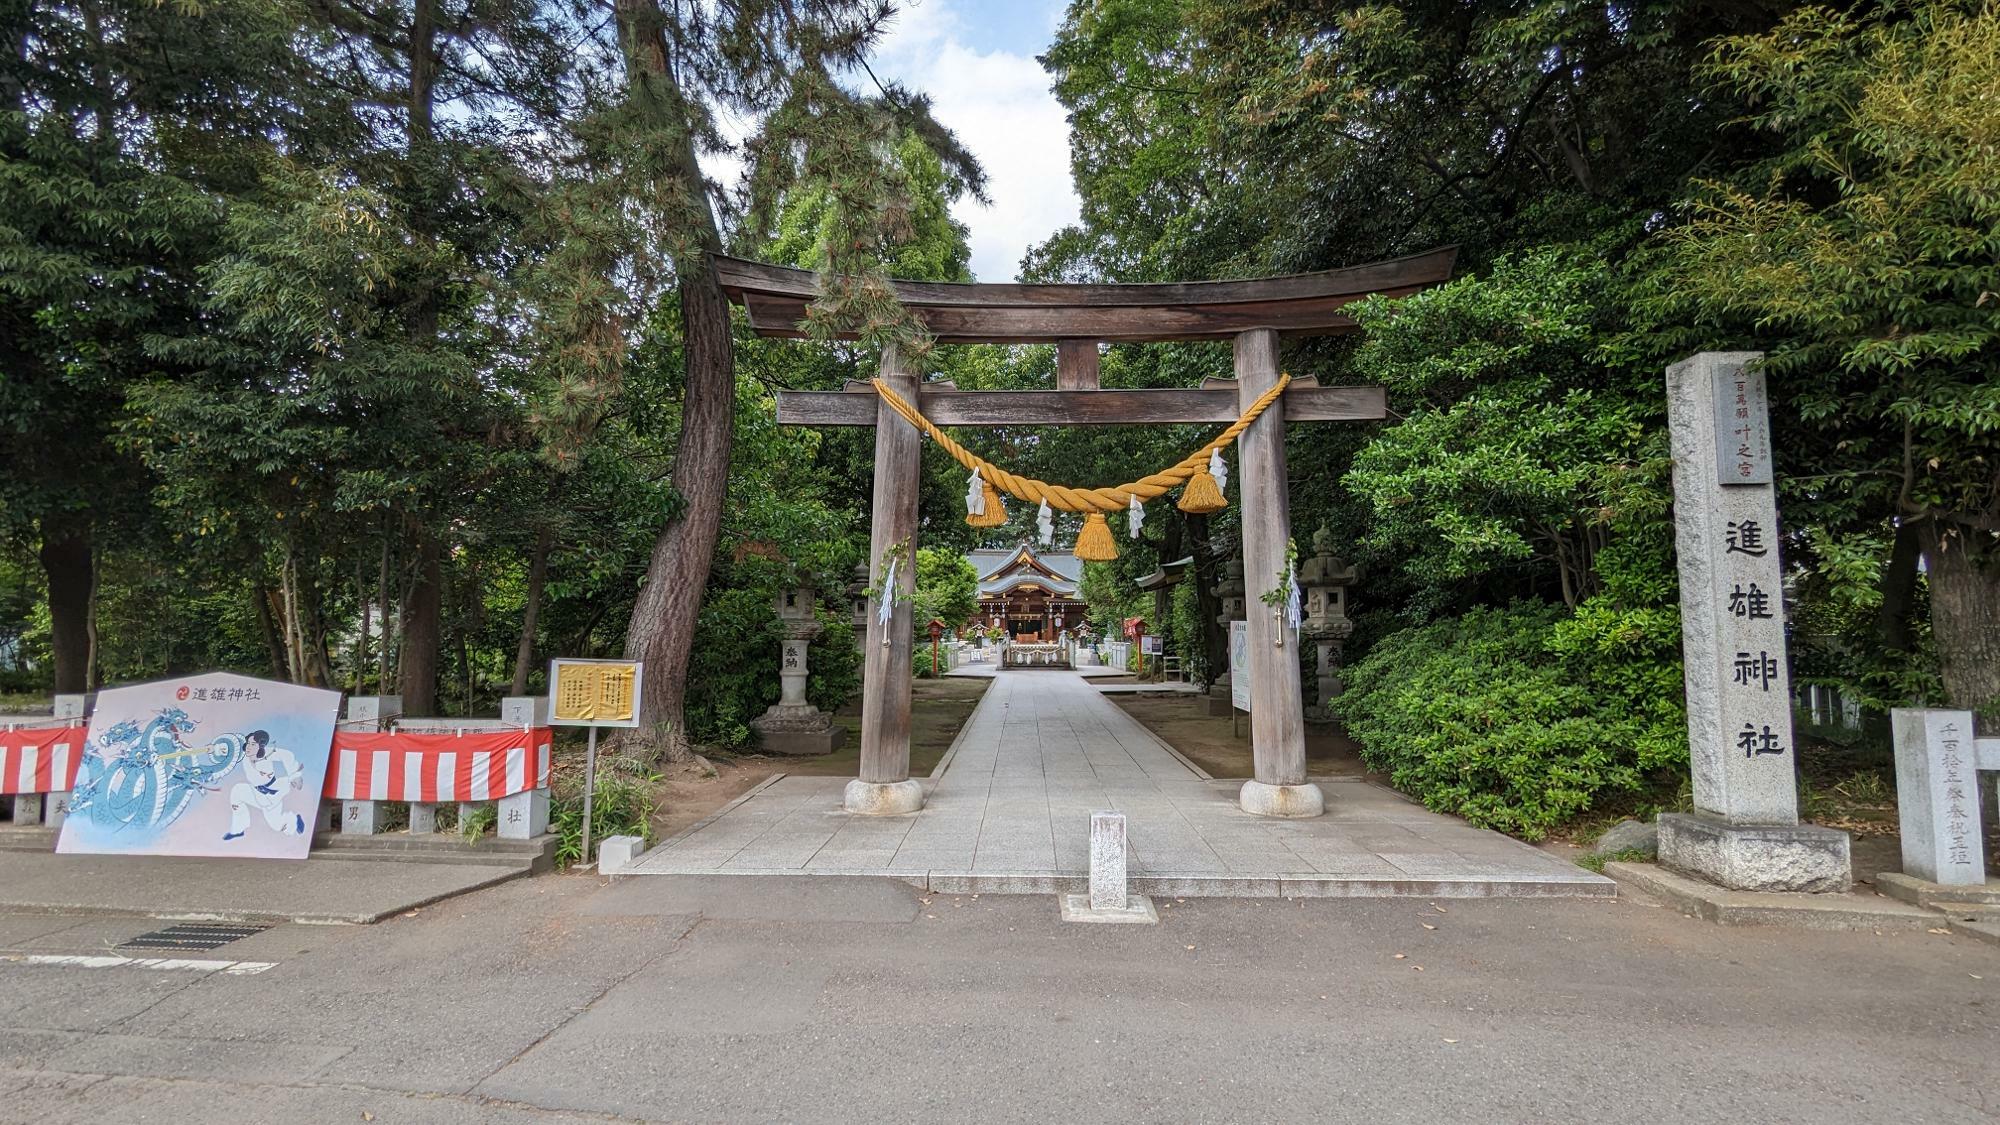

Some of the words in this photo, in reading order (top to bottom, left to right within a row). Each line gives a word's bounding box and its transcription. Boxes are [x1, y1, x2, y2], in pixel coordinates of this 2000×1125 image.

[1725, 519, 1785, 759] 進雄神社
[785, 646, 799, 668] 奉納
[192, 687, 261, 701] 進雄神社
[507, 807, 522, 825] 壮
